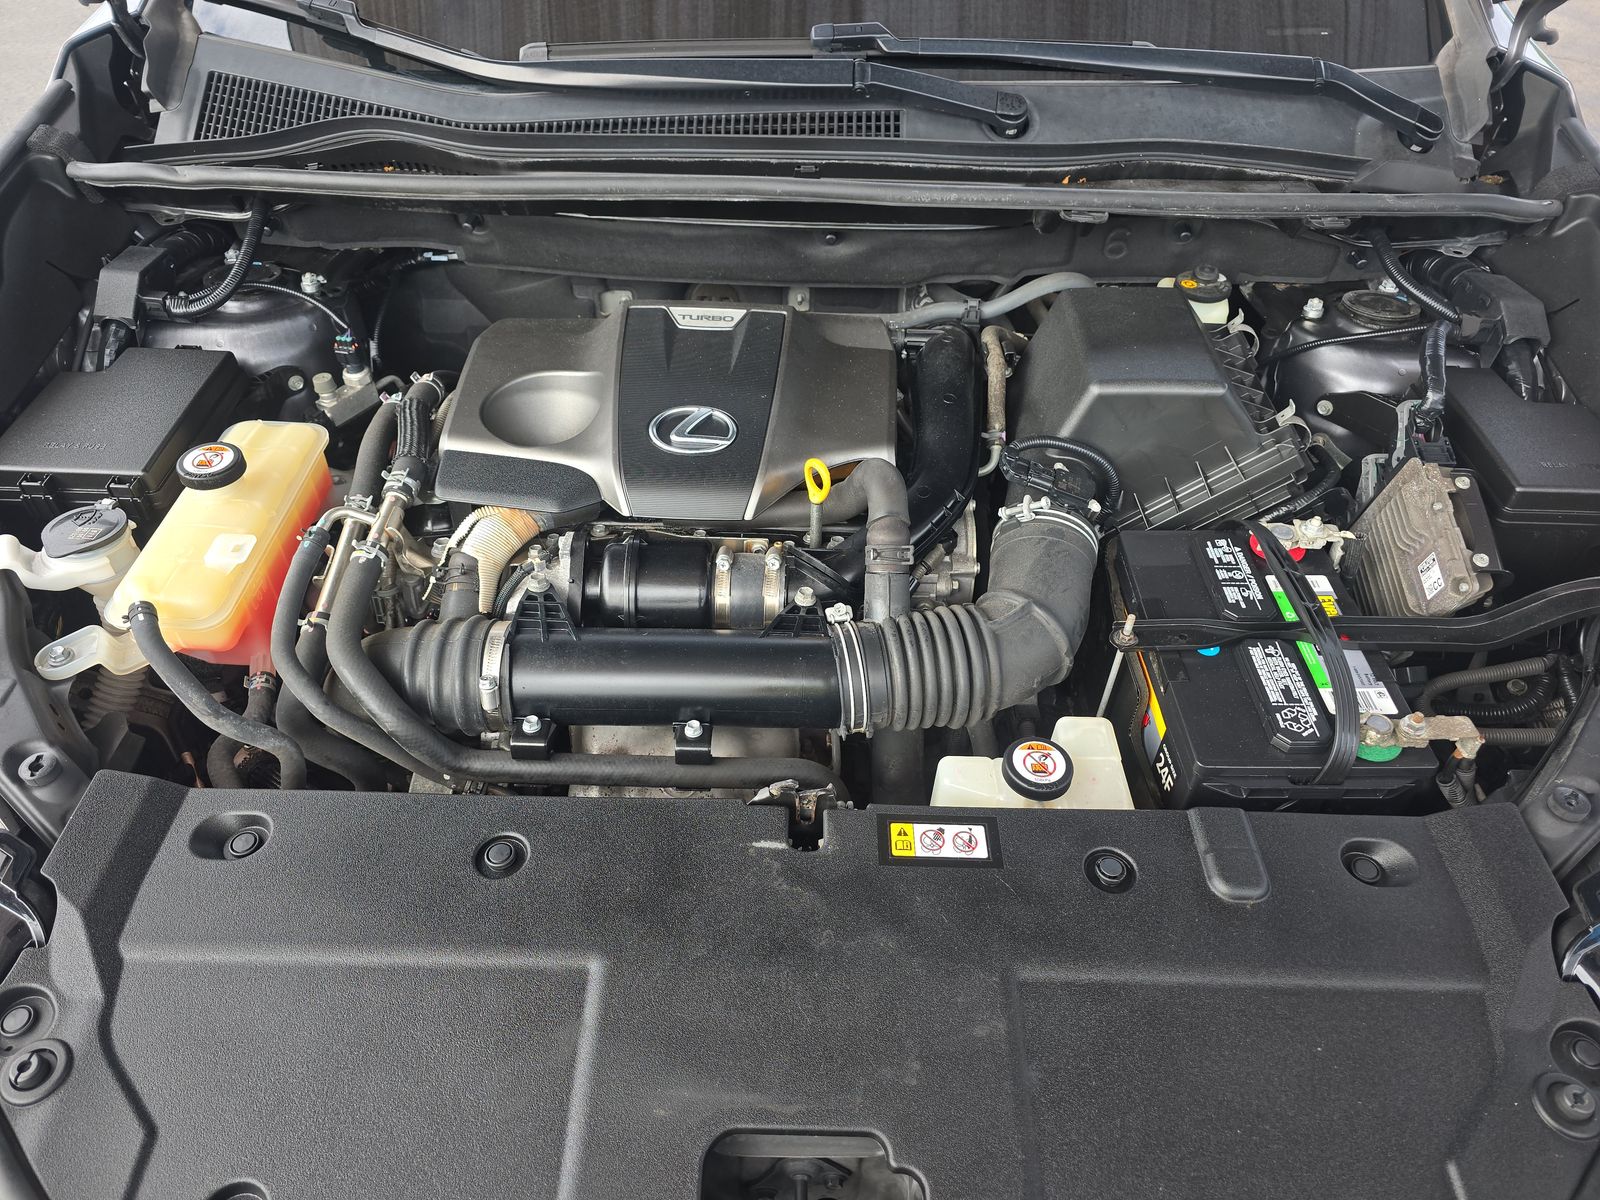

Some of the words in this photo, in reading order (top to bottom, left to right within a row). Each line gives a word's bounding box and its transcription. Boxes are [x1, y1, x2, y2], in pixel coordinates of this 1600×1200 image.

[678, 313, 734, 322] TURBO
[1236, 551, 1252, 575] DANGER
[1248, 578, 1264, 600] POISON
[1155, 752, 1175, 792] 24F
